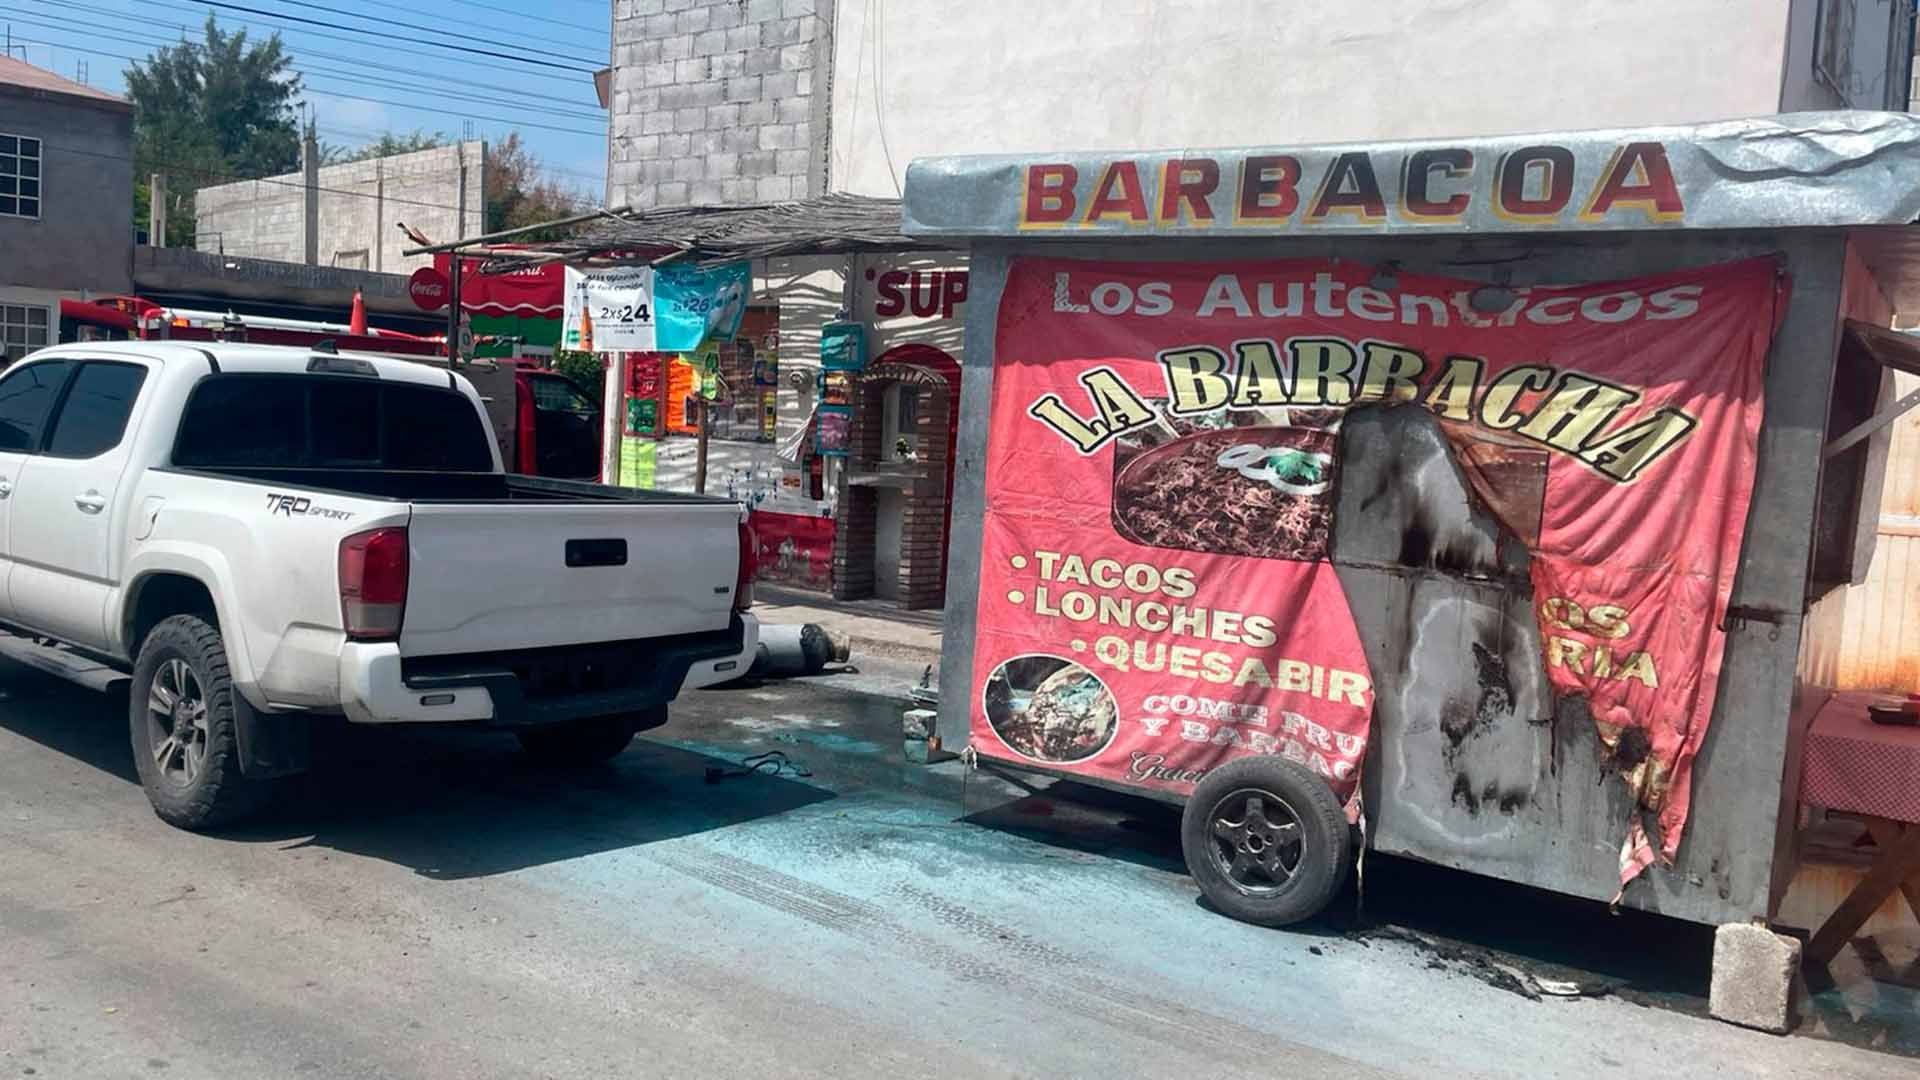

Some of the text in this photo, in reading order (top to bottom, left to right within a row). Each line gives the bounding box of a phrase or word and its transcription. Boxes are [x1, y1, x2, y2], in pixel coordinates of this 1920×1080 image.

[1018, 141, 1686, 230] BARBACOA
[1053, 272, 1174, 317] Los
[1028, 335, 1701, 484] LA BARBACHA
[266, 493, 355, 520] TRD SPORT
[1034, 550, 1198, 599] TACOS
[1033, 584, 1277, 649] LONCHES
[1140, 717, 1169, 737] Y
[1142, 694, 1268, 728] COME
